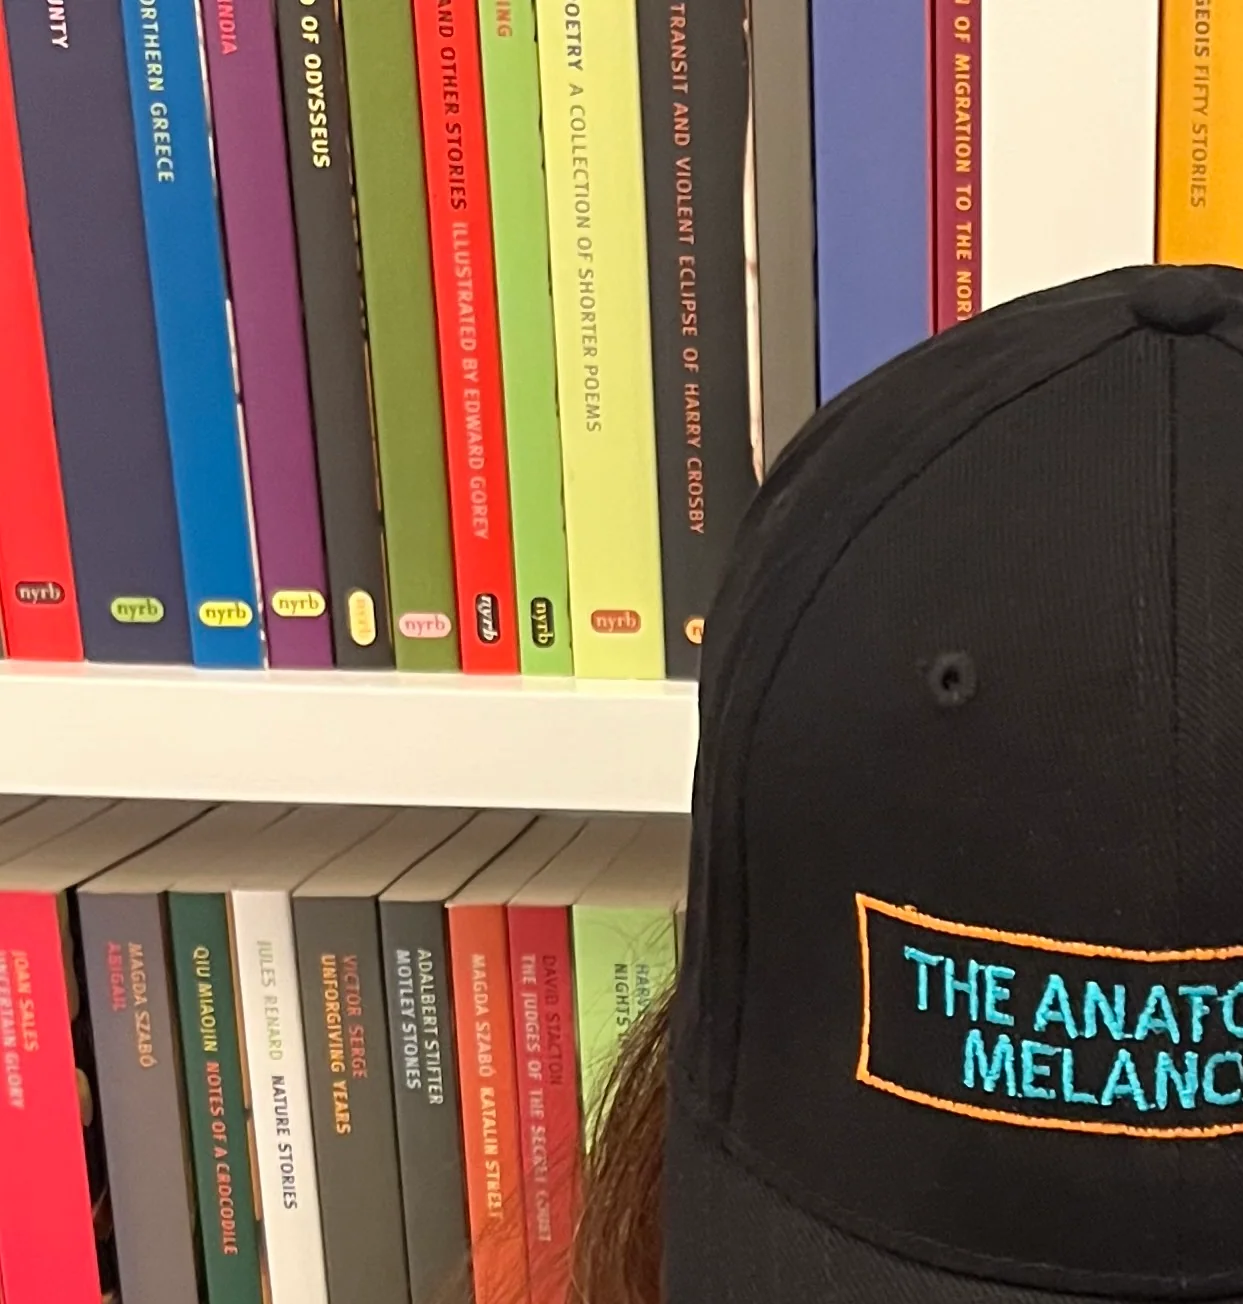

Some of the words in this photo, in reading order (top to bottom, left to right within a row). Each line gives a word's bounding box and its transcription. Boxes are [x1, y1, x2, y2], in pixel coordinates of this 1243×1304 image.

[300, 16, 320, 44] OF
[437, 0, 454, 38] AND
[670, 3, 689, 94] TRANSIT
[954, 16, 971, 44] OF
[304, 53, 330, 168] ODYSSEUS
[440, 46, 460, 115] OTHER
[1193, 65, 1210, 116] FIFTY
[150, 102, 174, 183] GREECE
[673, 102, 691, 146] AND
[954, 54, 972, 173] MIGRATION
[446, 122, 467, 211] STORIES
[569, 105, 591, 228] COLLECTION
[1190, 123, 1209, 209] STORIES
[675, 156, 695, 245] VIOLENT
[955, 184, 973, 211] TO
[576, 236, 594, 264] OF
[956, 222, 973, 260] THE
[452, 222, 477, 351] ILLUSTRATED
[578, 268, 598, 358] SHORTER
[678, 255, 698, 336] ECLIPSE
[462, 359, 479, 383] BY
[683, 348, 699, 374] OF
[464, 388, 485, 470] EDWARD
[584, 365, 602, 432] POEMS
[684, 383, 701, 448] HARRY
[469, 475, 489, 540] GOREY
[687, 457, 705, 534] CROSBY
[117, 597, 158, 620] nyrb
[205, 603, 247, 624] nyrb
[279, 594, 320, 615] nyrb
[406, 615, 446, 635] nyrb
[477, 595, 498, 642] nyrb
[530, 601, 555, 644] nyrb
[595, 612, 637, 631] nyrb
[12, 950, 32, 994] JOAN
[128, 941, 148, 1007] MAGDA
[192, 945, 211, 978] QIU
[257, 940, 276, 988] JULES
[342, 954, 362, 1017] VICTOR
[396, 949, 416, 1020] MOTLEY
[417, 948, 437, 1036] ADALBERT
[471, 953, 490, 1016] MAGDA
[521, 954, 536, 985] THE
[542, 955, 560, 1008] DAVID
[904, 945, 1016, 1028] THE
[21, 998, 39, 1052] SALES
[135, 1010, 158, 1068] SZABÓ
[198, 982, 218, 1052] MIAOJIN
[265, 995, 284, 1061] RENARD
[321, 953, 346, 1073] UNFORGIVING
[520, 991, 541, 1053] JUDGES
[349, 1024, 368, 1080] SERGE
[402, 1022, 422, 1090] STONES
[424, 1040, 444, 1105] STIFTER
[475, 1020, 495, 1078] SZABÓ
[526, 1060, 542, 1081] OF
[545, 1011, 564, 1087] STACTON
[5, 1052, 25, 1110] GLORY
[206, 1061, 224, 1116] NOTES
[271, 1074, 290, 1136] NATURE
[333, 1079, 351, 1136] YEARS
[528, 1087, 544, 1118] THE
[211, 1120, 228, 1143] OF
[480, 1086, 499, 1155] KATALIN
[278, 1142, 298, 1210] STORIES
[530, 1124, 549, 1186] SECRET
[216, 1162, 239, 1256] CROCODILE
